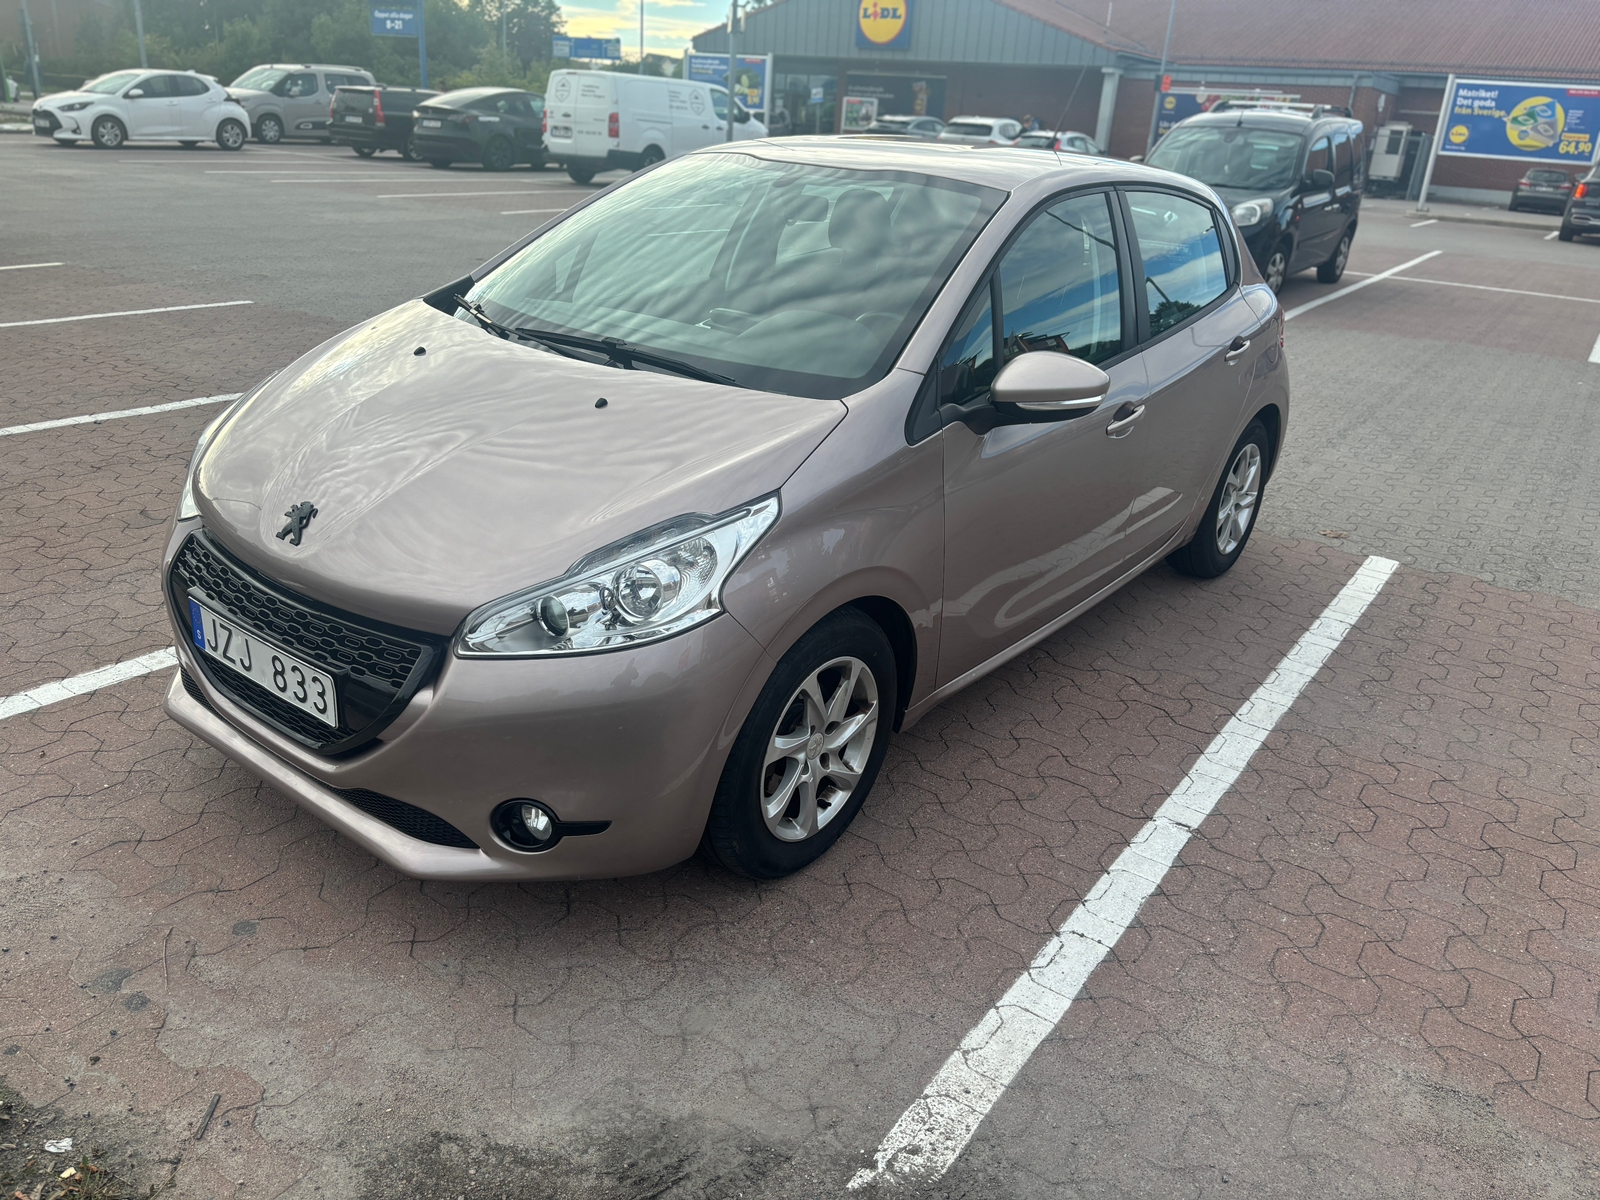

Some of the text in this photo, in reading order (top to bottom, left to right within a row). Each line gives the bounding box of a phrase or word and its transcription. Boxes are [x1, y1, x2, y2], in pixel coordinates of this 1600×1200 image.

[1457, 88, 1499, 99] Matriket!
[1456, 97, 1496, 108] Det goda
[1454, 105, 1472, 115] från
[196, 629, 202, 640] S
[206, 618, 328, 715] JZJ 833
